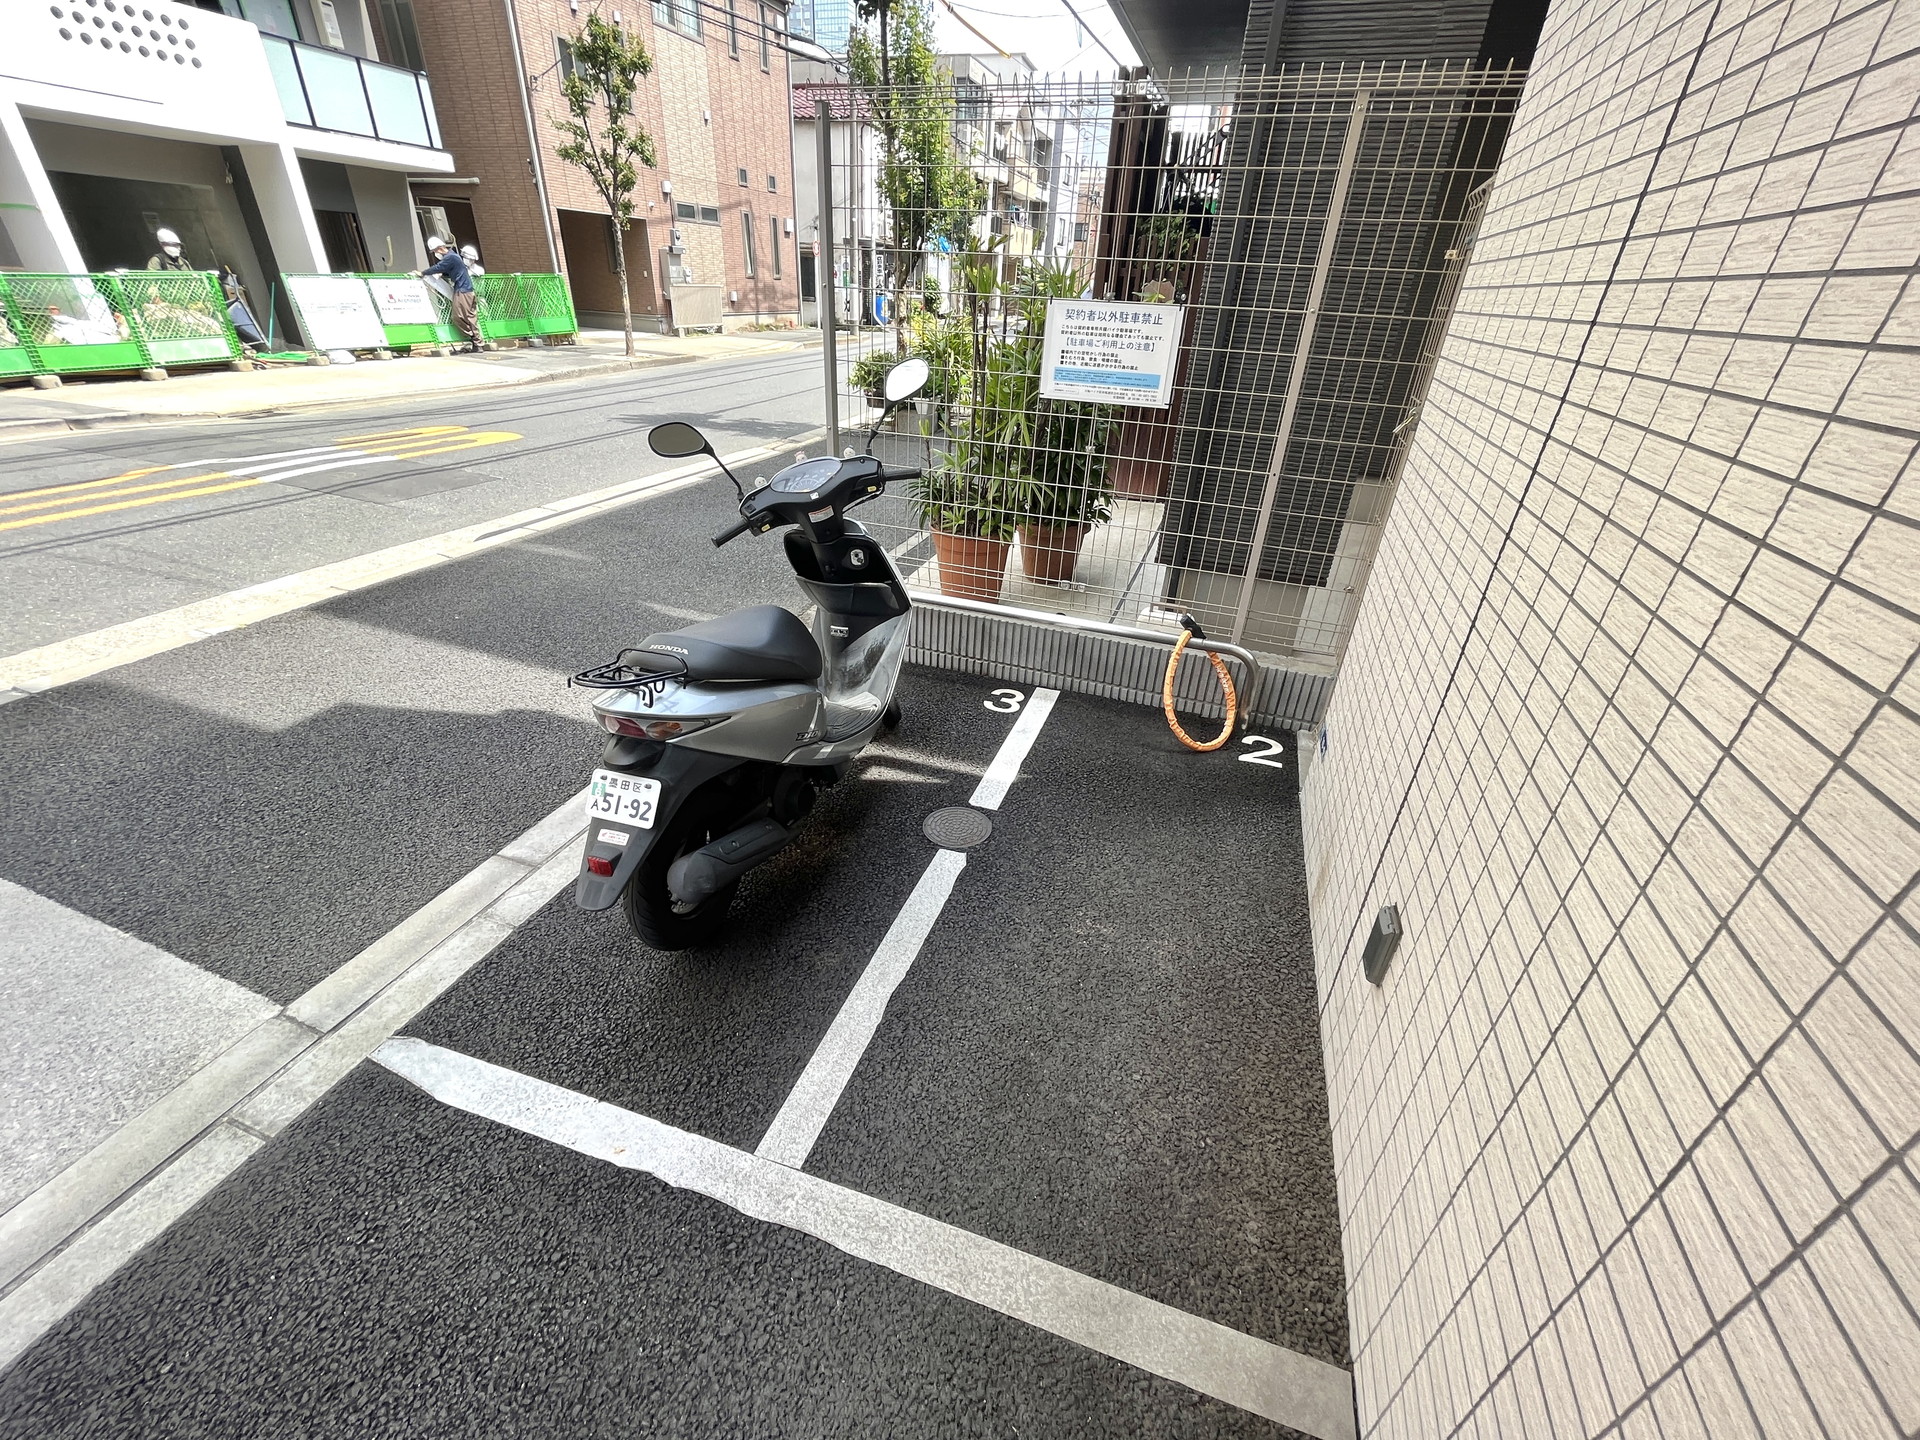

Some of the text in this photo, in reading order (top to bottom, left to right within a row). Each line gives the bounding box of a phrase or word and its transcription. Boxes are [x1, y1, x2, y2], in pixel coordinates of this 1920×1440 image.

[1065, 308, 1163, 326] 契約者以外駐車禁止
[1066, 337, 1155, 352] 【駐車場ご利用上の注意】
[648, 643, 689, 655] HONDA
[983, 688, 1025, 713] 3
[1238, 735, 1284, 769] 2
[590, 792, 652, 822] A 51-92
